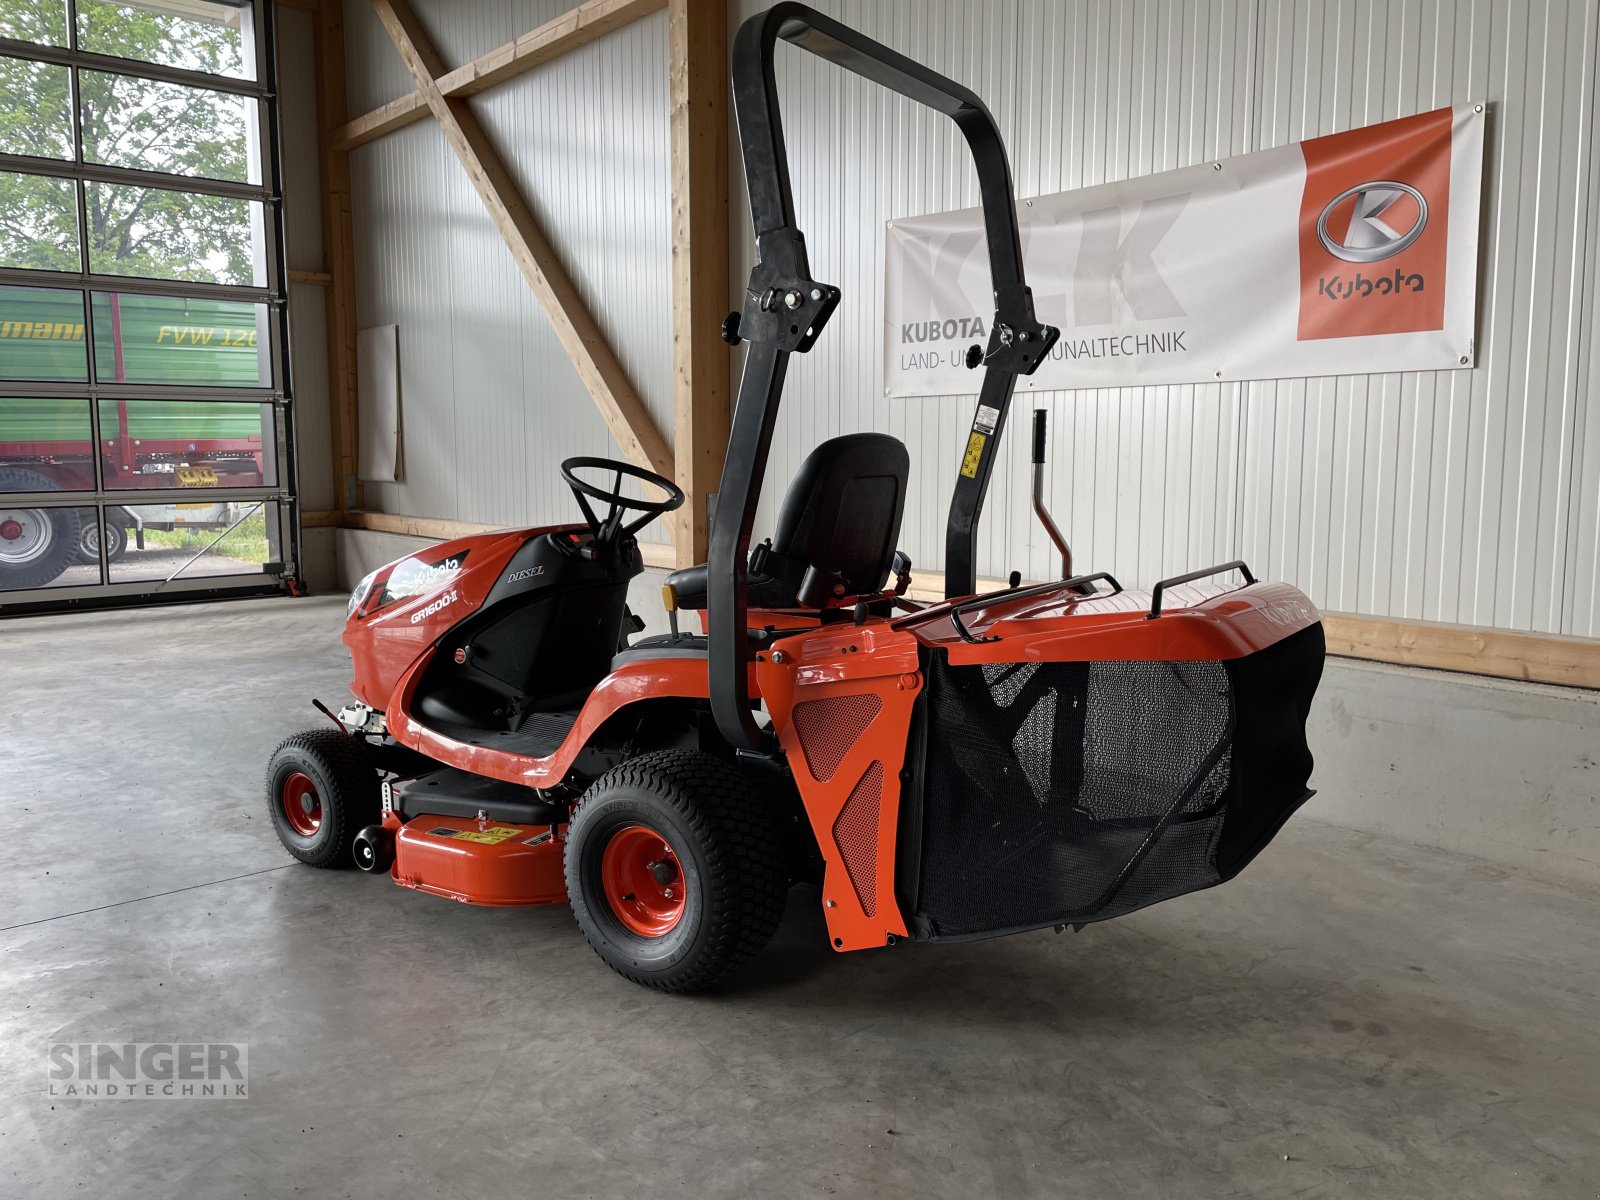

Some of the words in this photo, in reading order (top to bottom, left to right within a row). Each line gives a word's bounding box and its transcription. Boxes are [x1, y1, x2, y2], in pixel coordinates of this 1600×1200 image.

[1319, 268, 1424, 300] Kubota
[157, 326, 214, 345] FVW
[902, 317, 986, 344] KUBOTA
[901, 351, 945, 370] LAND-
[1047, 330, 1186, 361] UNALTECHNIK
[506, 565, 544, 584] DIESEL
